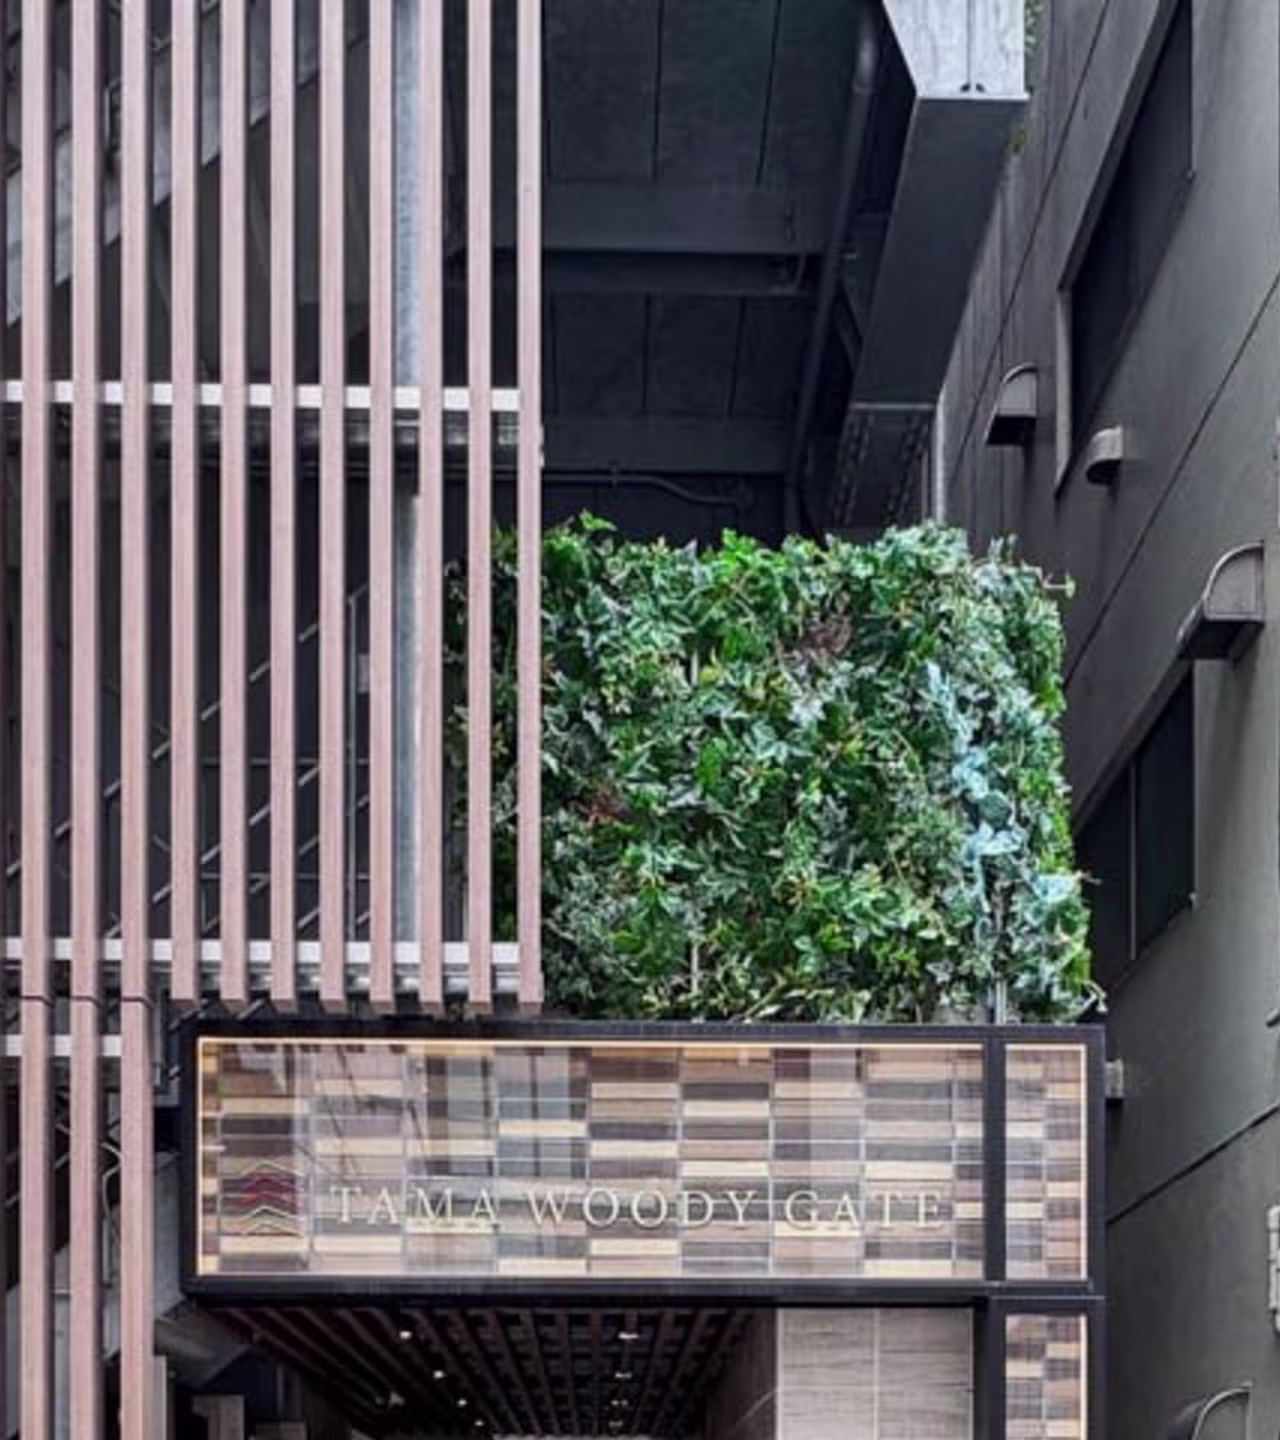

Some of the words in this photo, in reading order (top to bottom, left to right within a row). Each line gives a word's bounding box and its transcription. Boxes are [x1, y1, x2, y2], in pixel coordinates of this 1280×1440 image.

[330, 1185, 500, 1227] TAMA
[526, 1184, 758, 1230] WOODY
[782, 1188, 946, 1231] GATE
